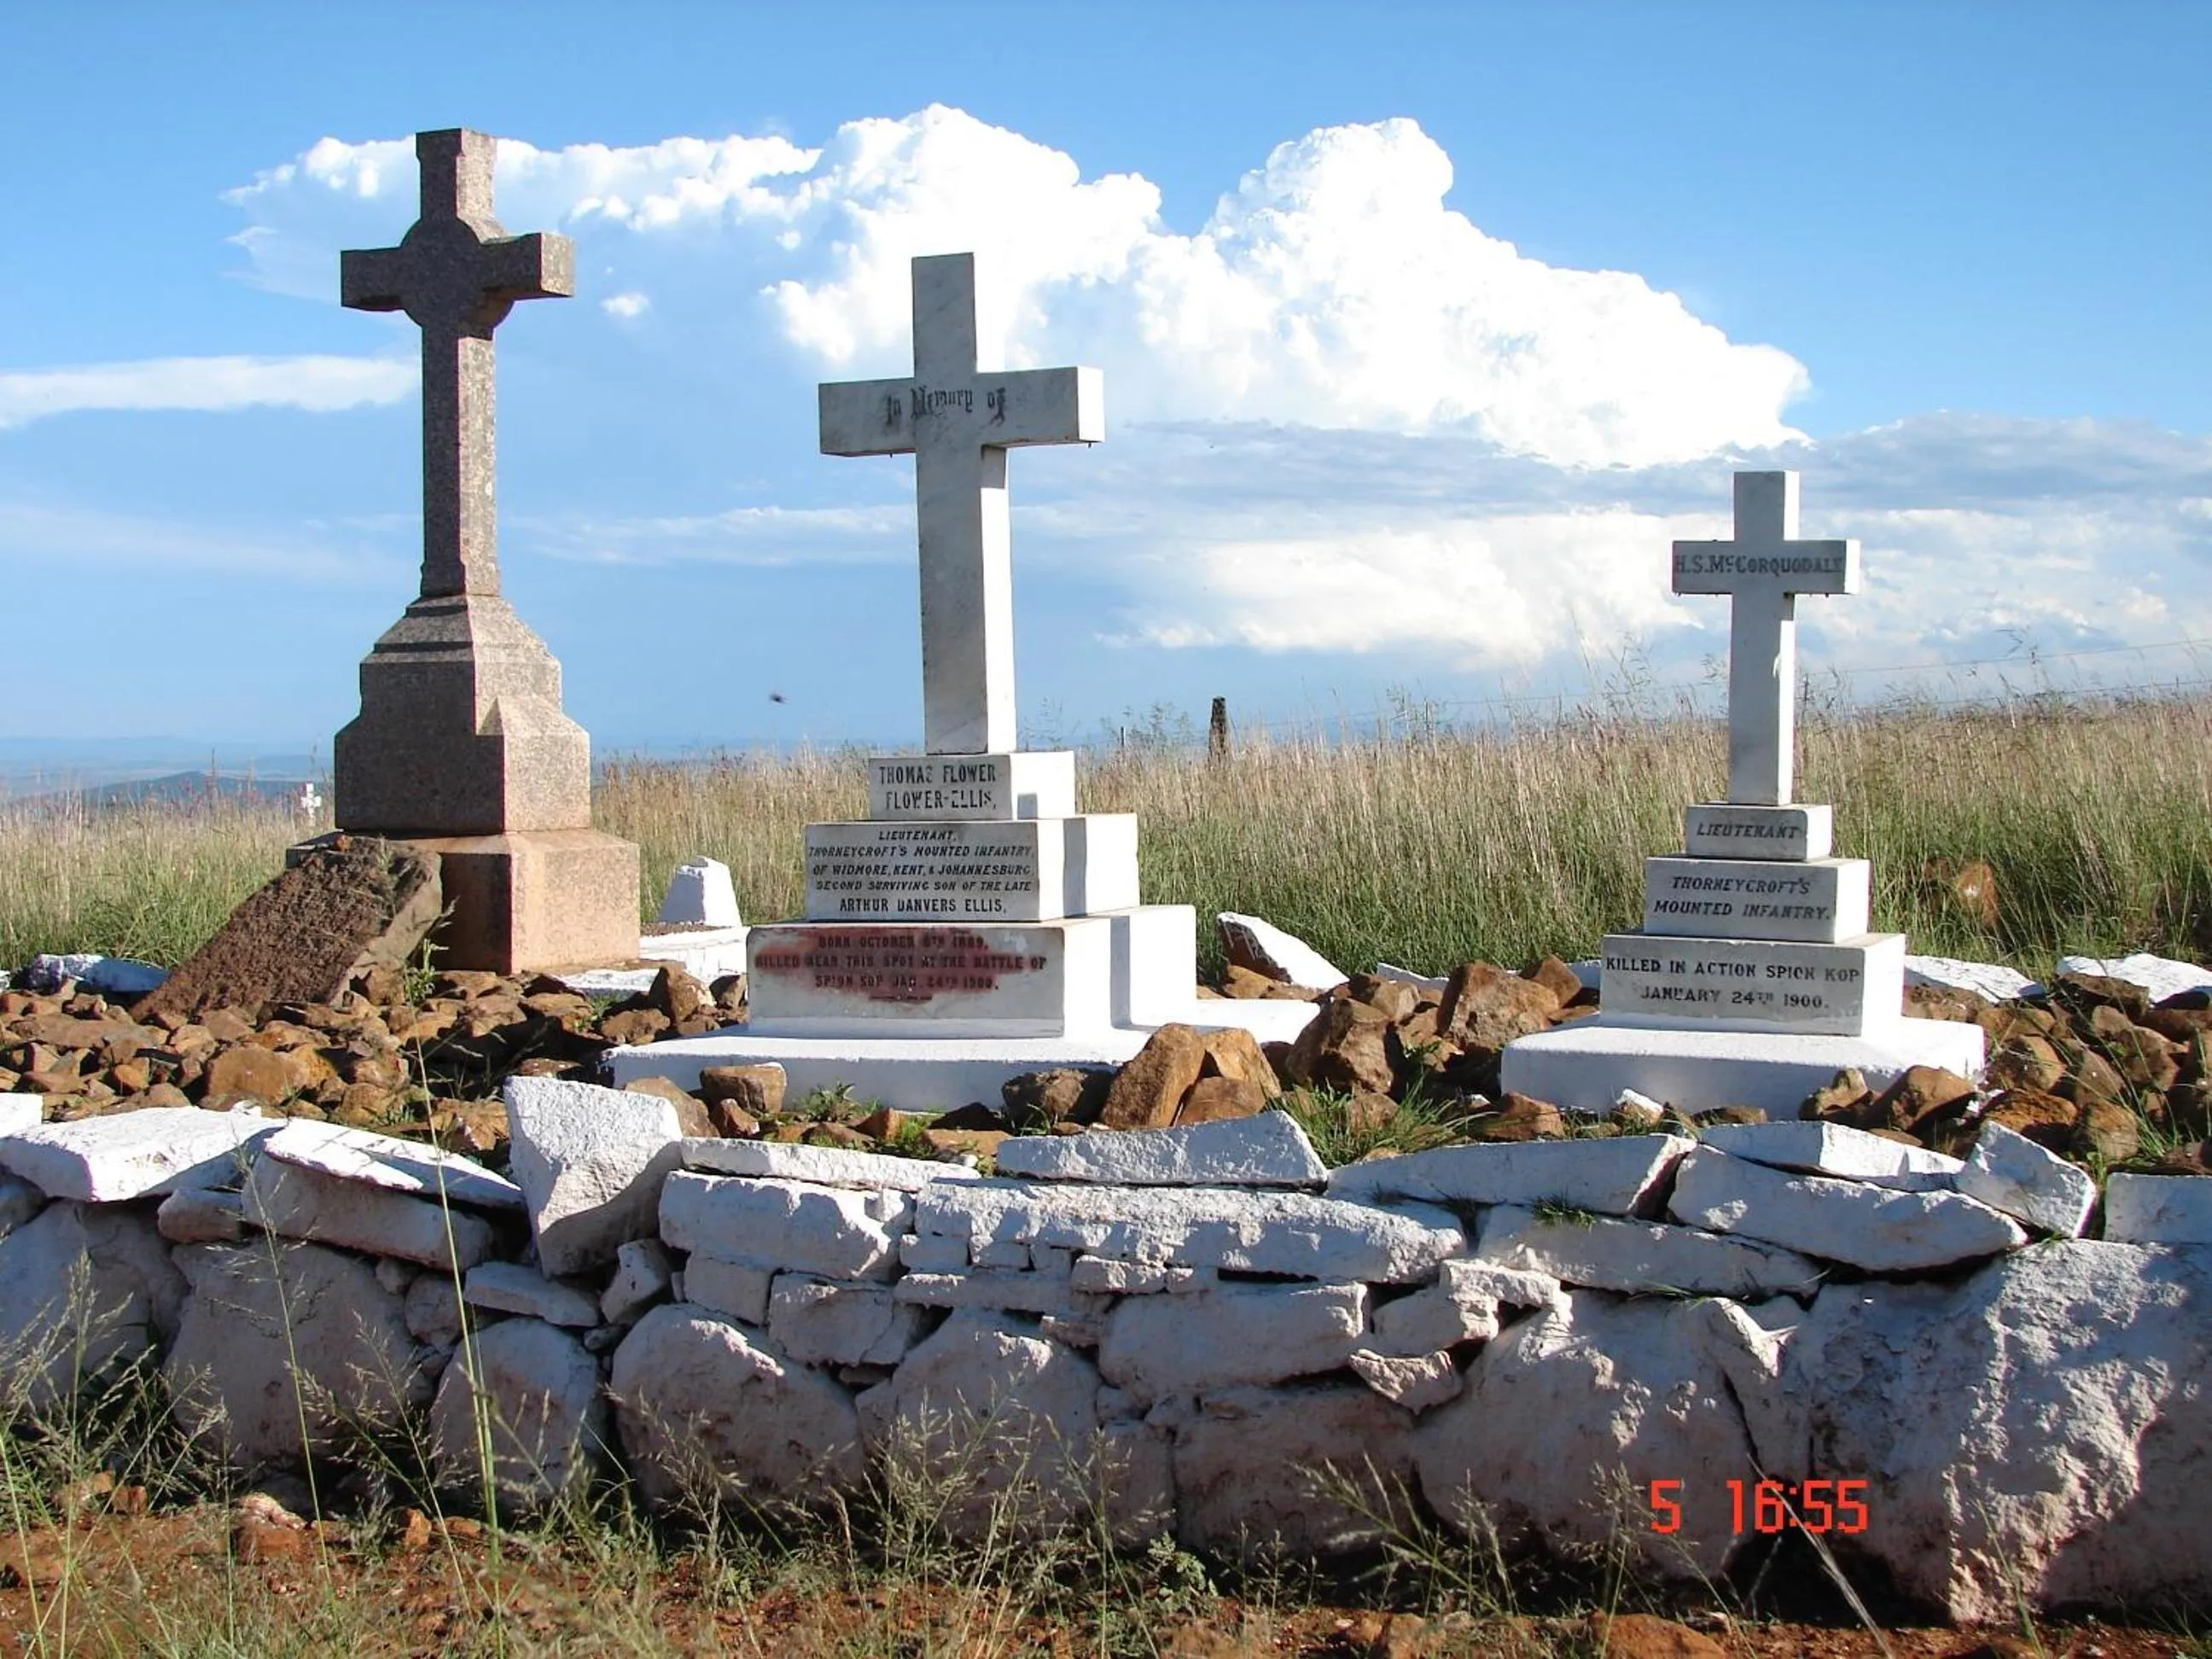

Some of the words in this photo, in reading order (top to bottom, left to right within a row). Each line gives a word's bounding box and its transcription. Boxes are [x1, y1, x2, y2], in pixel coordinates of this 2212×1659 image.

[987, 387, 1007, 428] of
[879, 765, 934, 785] THOMAS
[943, 764, 997, 783] FLOWER
[808, 845, 907, 858] THORNEYCROFT'S
[913, 846, 970, 857] MOUNTED
[813, 864, 828, 876] OF
[816, 880, 863, 891] SECOND
[866, 881, 930, 891] SURVIVING
[934, 881, 957, 891] SON
[962, 882, 976, 891] OF
[981, 881, 1002, 892] THE
[1004, 881, 1032, 891] LATE
[1671, 876, 1811, 894] THORNEYCROFT'S
[840, 898, 889, 913] ARTHUR
[897, 899, 957, 912] DANVERS
[1653, 899, 1732, 917] MOUNTED
[1742, 903, 1831, 921] INFANTRY.
[860, 935, 915, 948] OCTOBER
[847, 955, 874, 968] THIS
[882, 955, 914, 968] SPOT
[943, 955, 967, 969] THE
[973, 955, 1024, 969] BATTLE
[1030, 956, 1047, 970] OF
[1605, 956, 1662, 973] KILLED
[1669, 959, 1685, 974] IN
[1695, 961, 1756, 977] ACTION
[1766, 965, 1815, 981] SPION
[1825, 968, 1860, 983] KOP
[1640, 986, 1721, 1004] JANUARY
